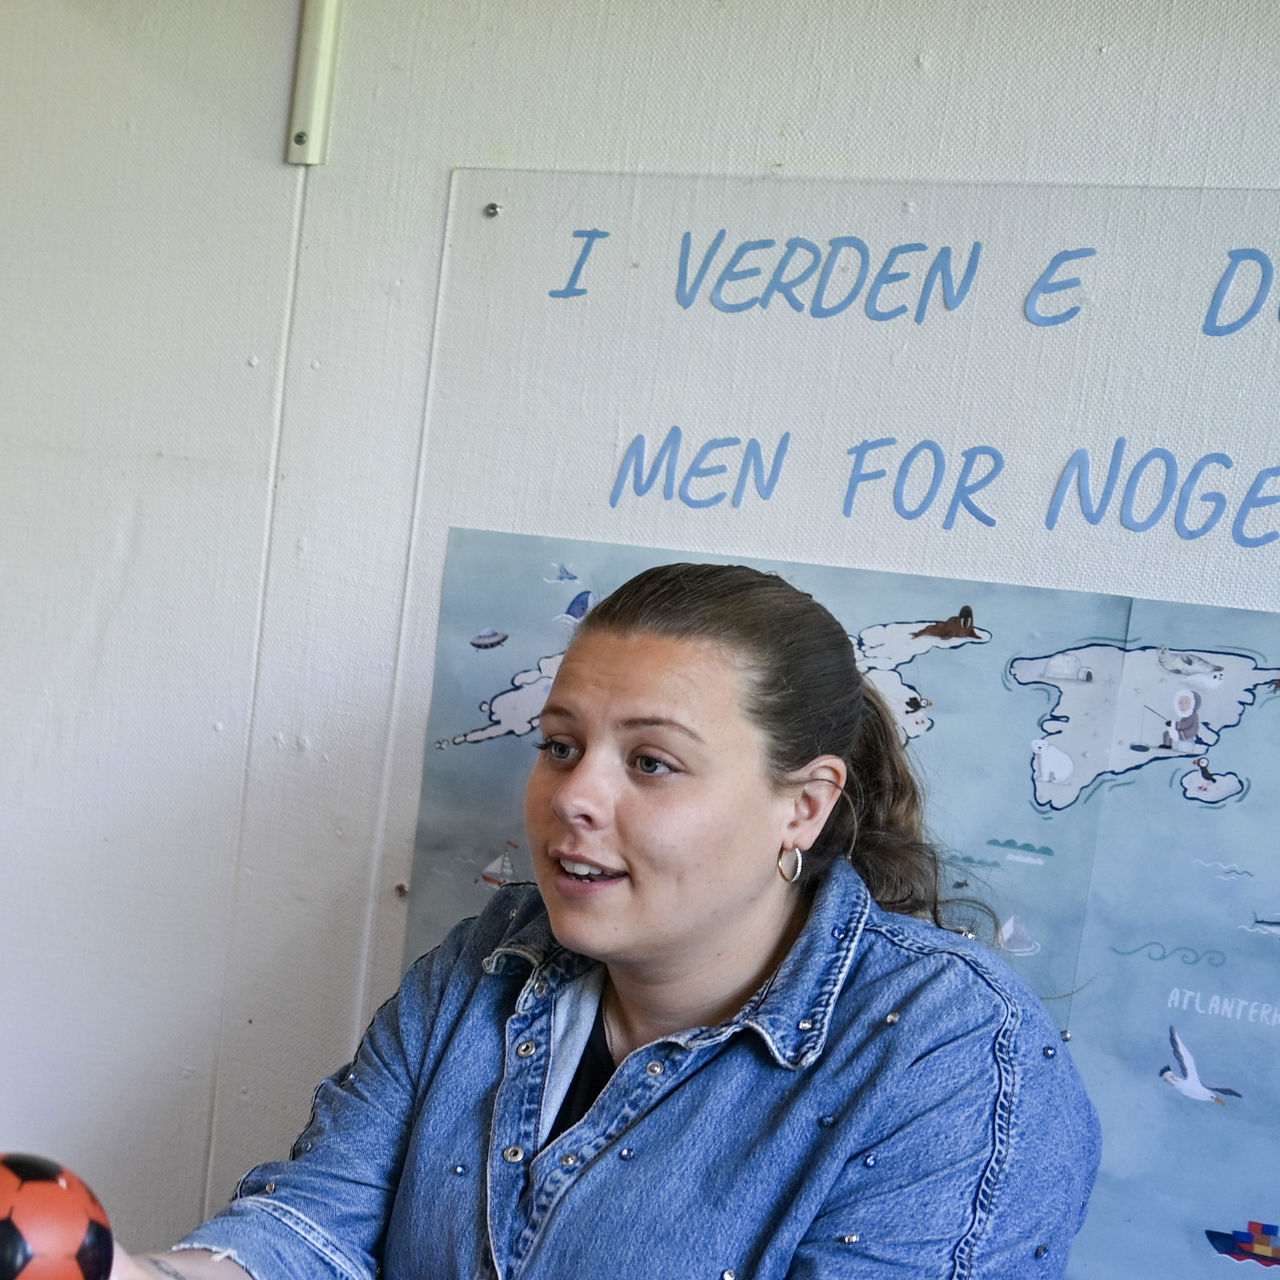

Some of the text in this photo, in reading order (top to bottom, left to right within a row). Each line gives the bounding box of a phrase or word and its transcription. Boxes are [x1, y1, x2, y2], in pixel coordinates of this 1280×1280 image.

[549, 228, 1280, 337] I VERDEN E D
[609, 425, 1280, 549] MEN FOR NOGE
